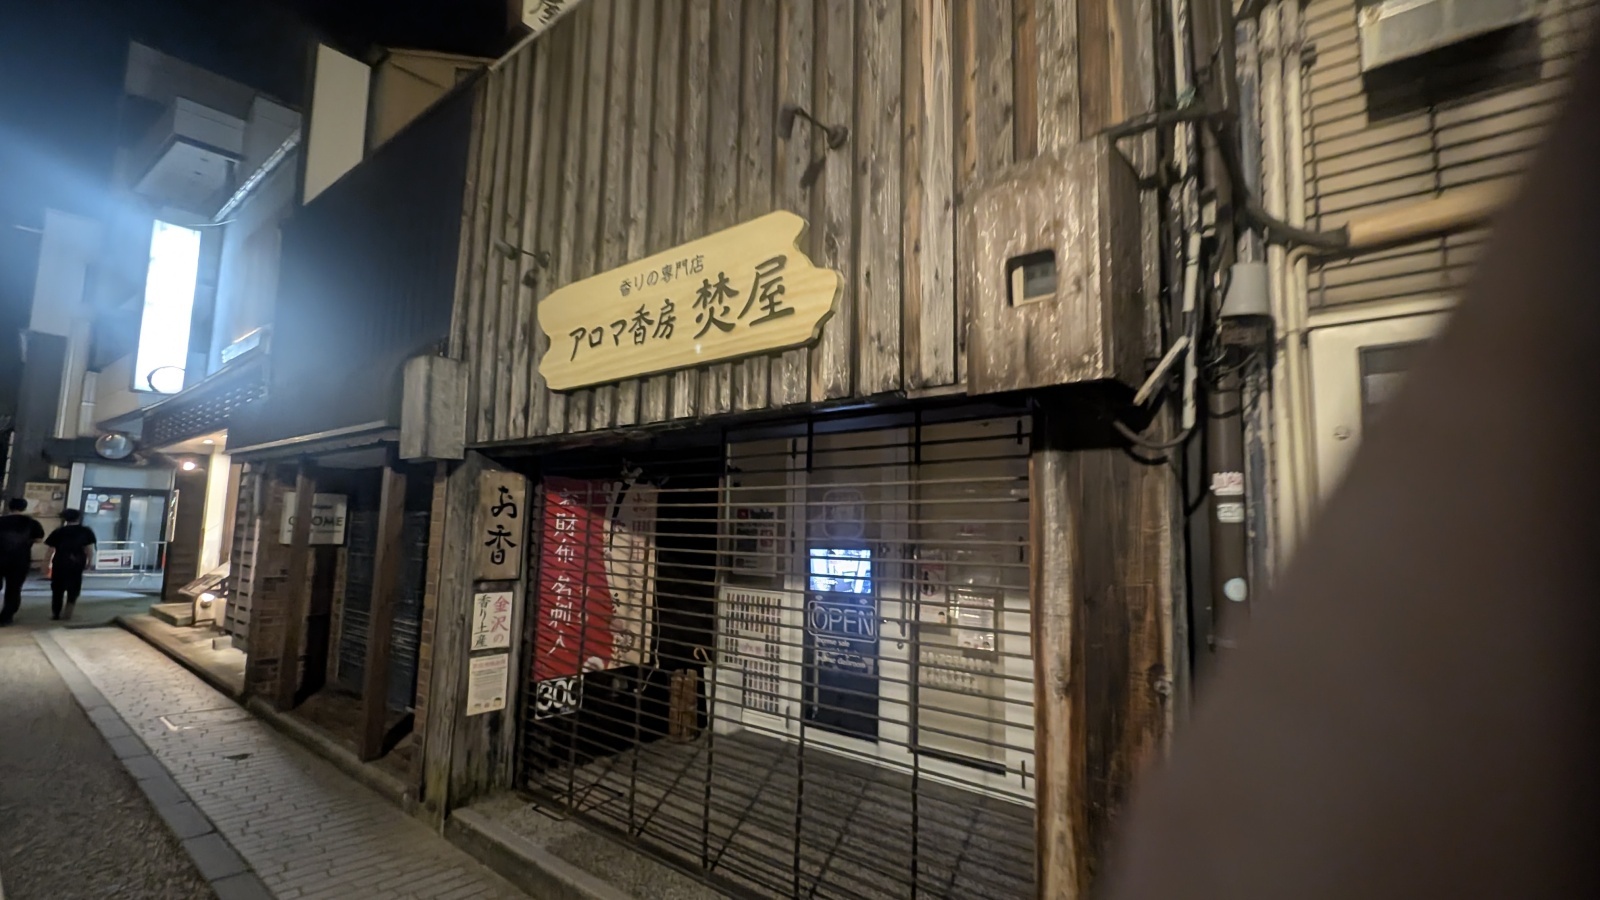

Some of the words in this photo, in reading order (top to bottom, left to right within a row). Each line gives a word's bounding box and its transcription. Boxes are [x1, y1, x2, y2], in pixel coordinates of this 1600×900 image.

[569, 299, 676, 361] アロマ香房
[692, 254, 795, 340] 焚屋
[484, 486, 518, 565] お香
[474, 594, 491, 648] 香り土産
[491, 595, 510, 643] 金沢の
[811, 605, 874, 636] OPEN
